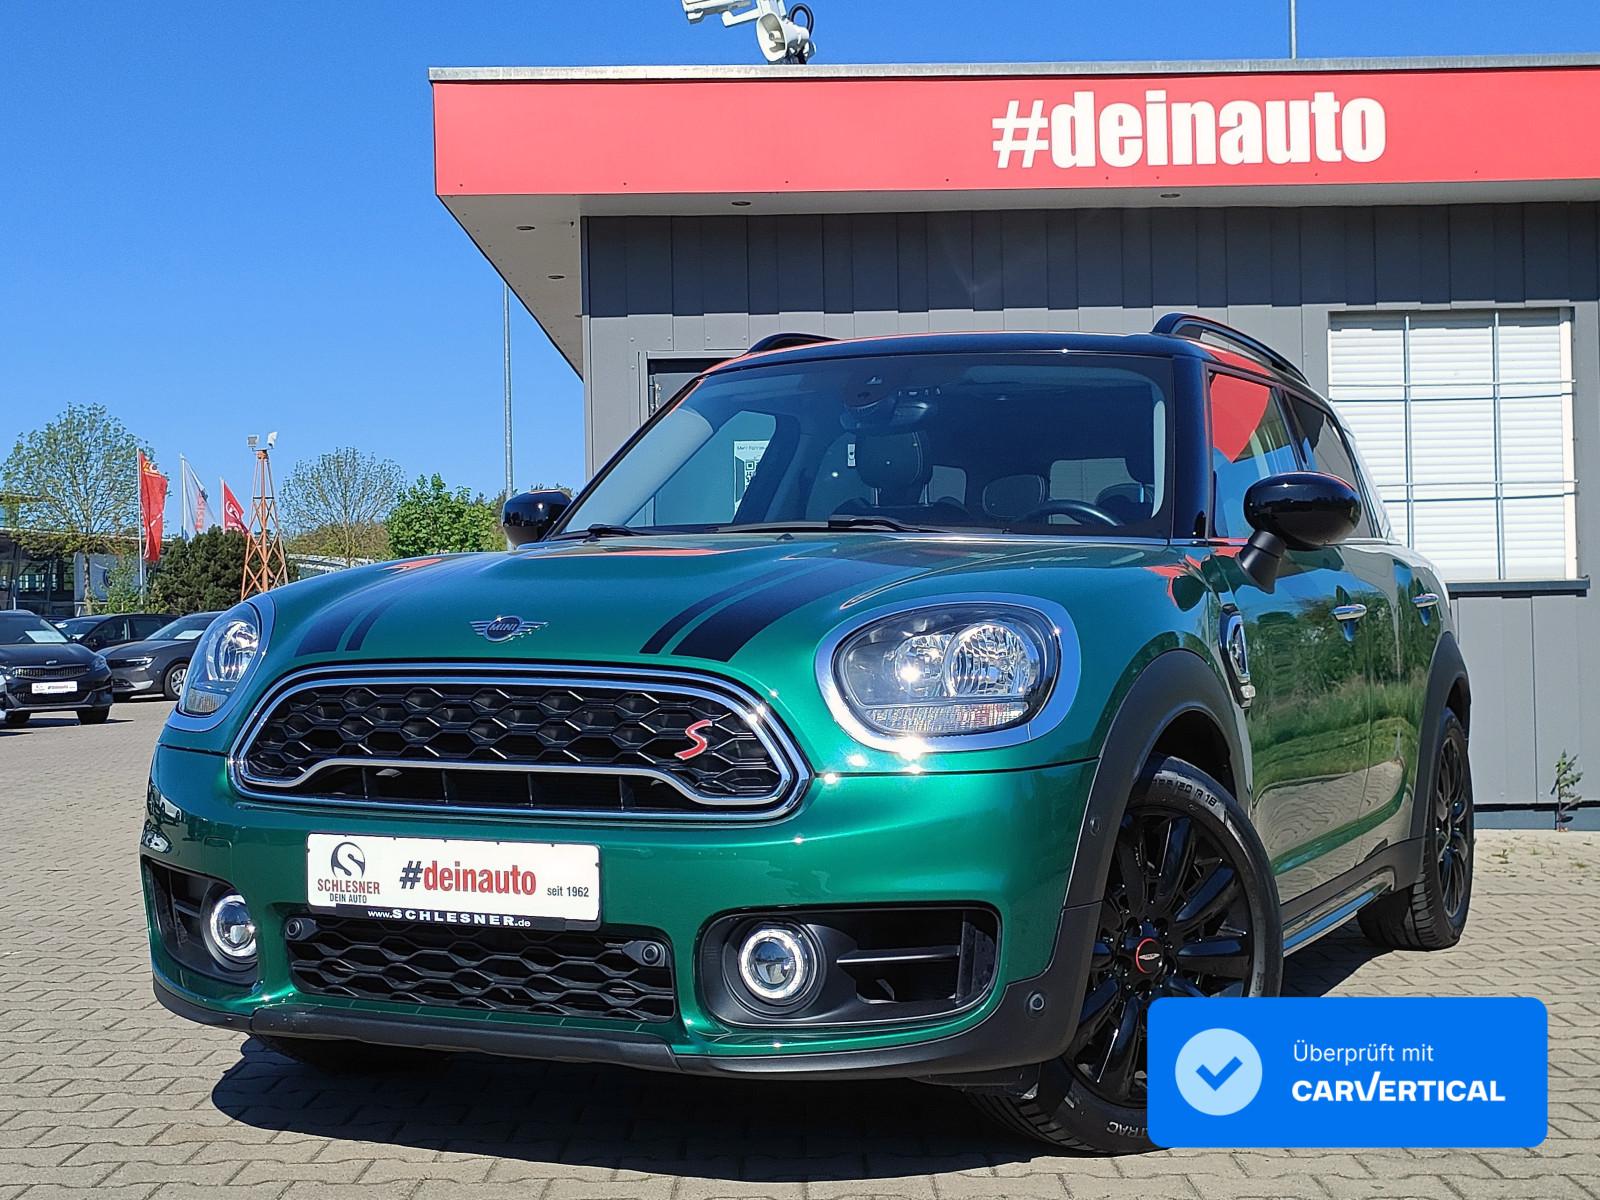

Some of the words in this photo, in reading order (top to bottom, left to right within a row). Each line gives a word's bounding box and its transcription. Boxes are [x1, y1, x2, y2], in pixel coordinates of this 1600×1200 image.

[992, 89, 1387, 169] #deinauto
[489, 623, 518, 631] MINI
[674, 719, 713, 760] S
[317, 878, 380, 895] SCHLESNER
[400, 860, 537, 896] #deinauto
[329, 892, 347, 903] DEIN
[348, 893, 368, 904] AUTO
[547, 886, 564, 897] seit
[566, 886, 589, 898] 1962
[367, 908, 531, 927] www.SCHLESNER.de
